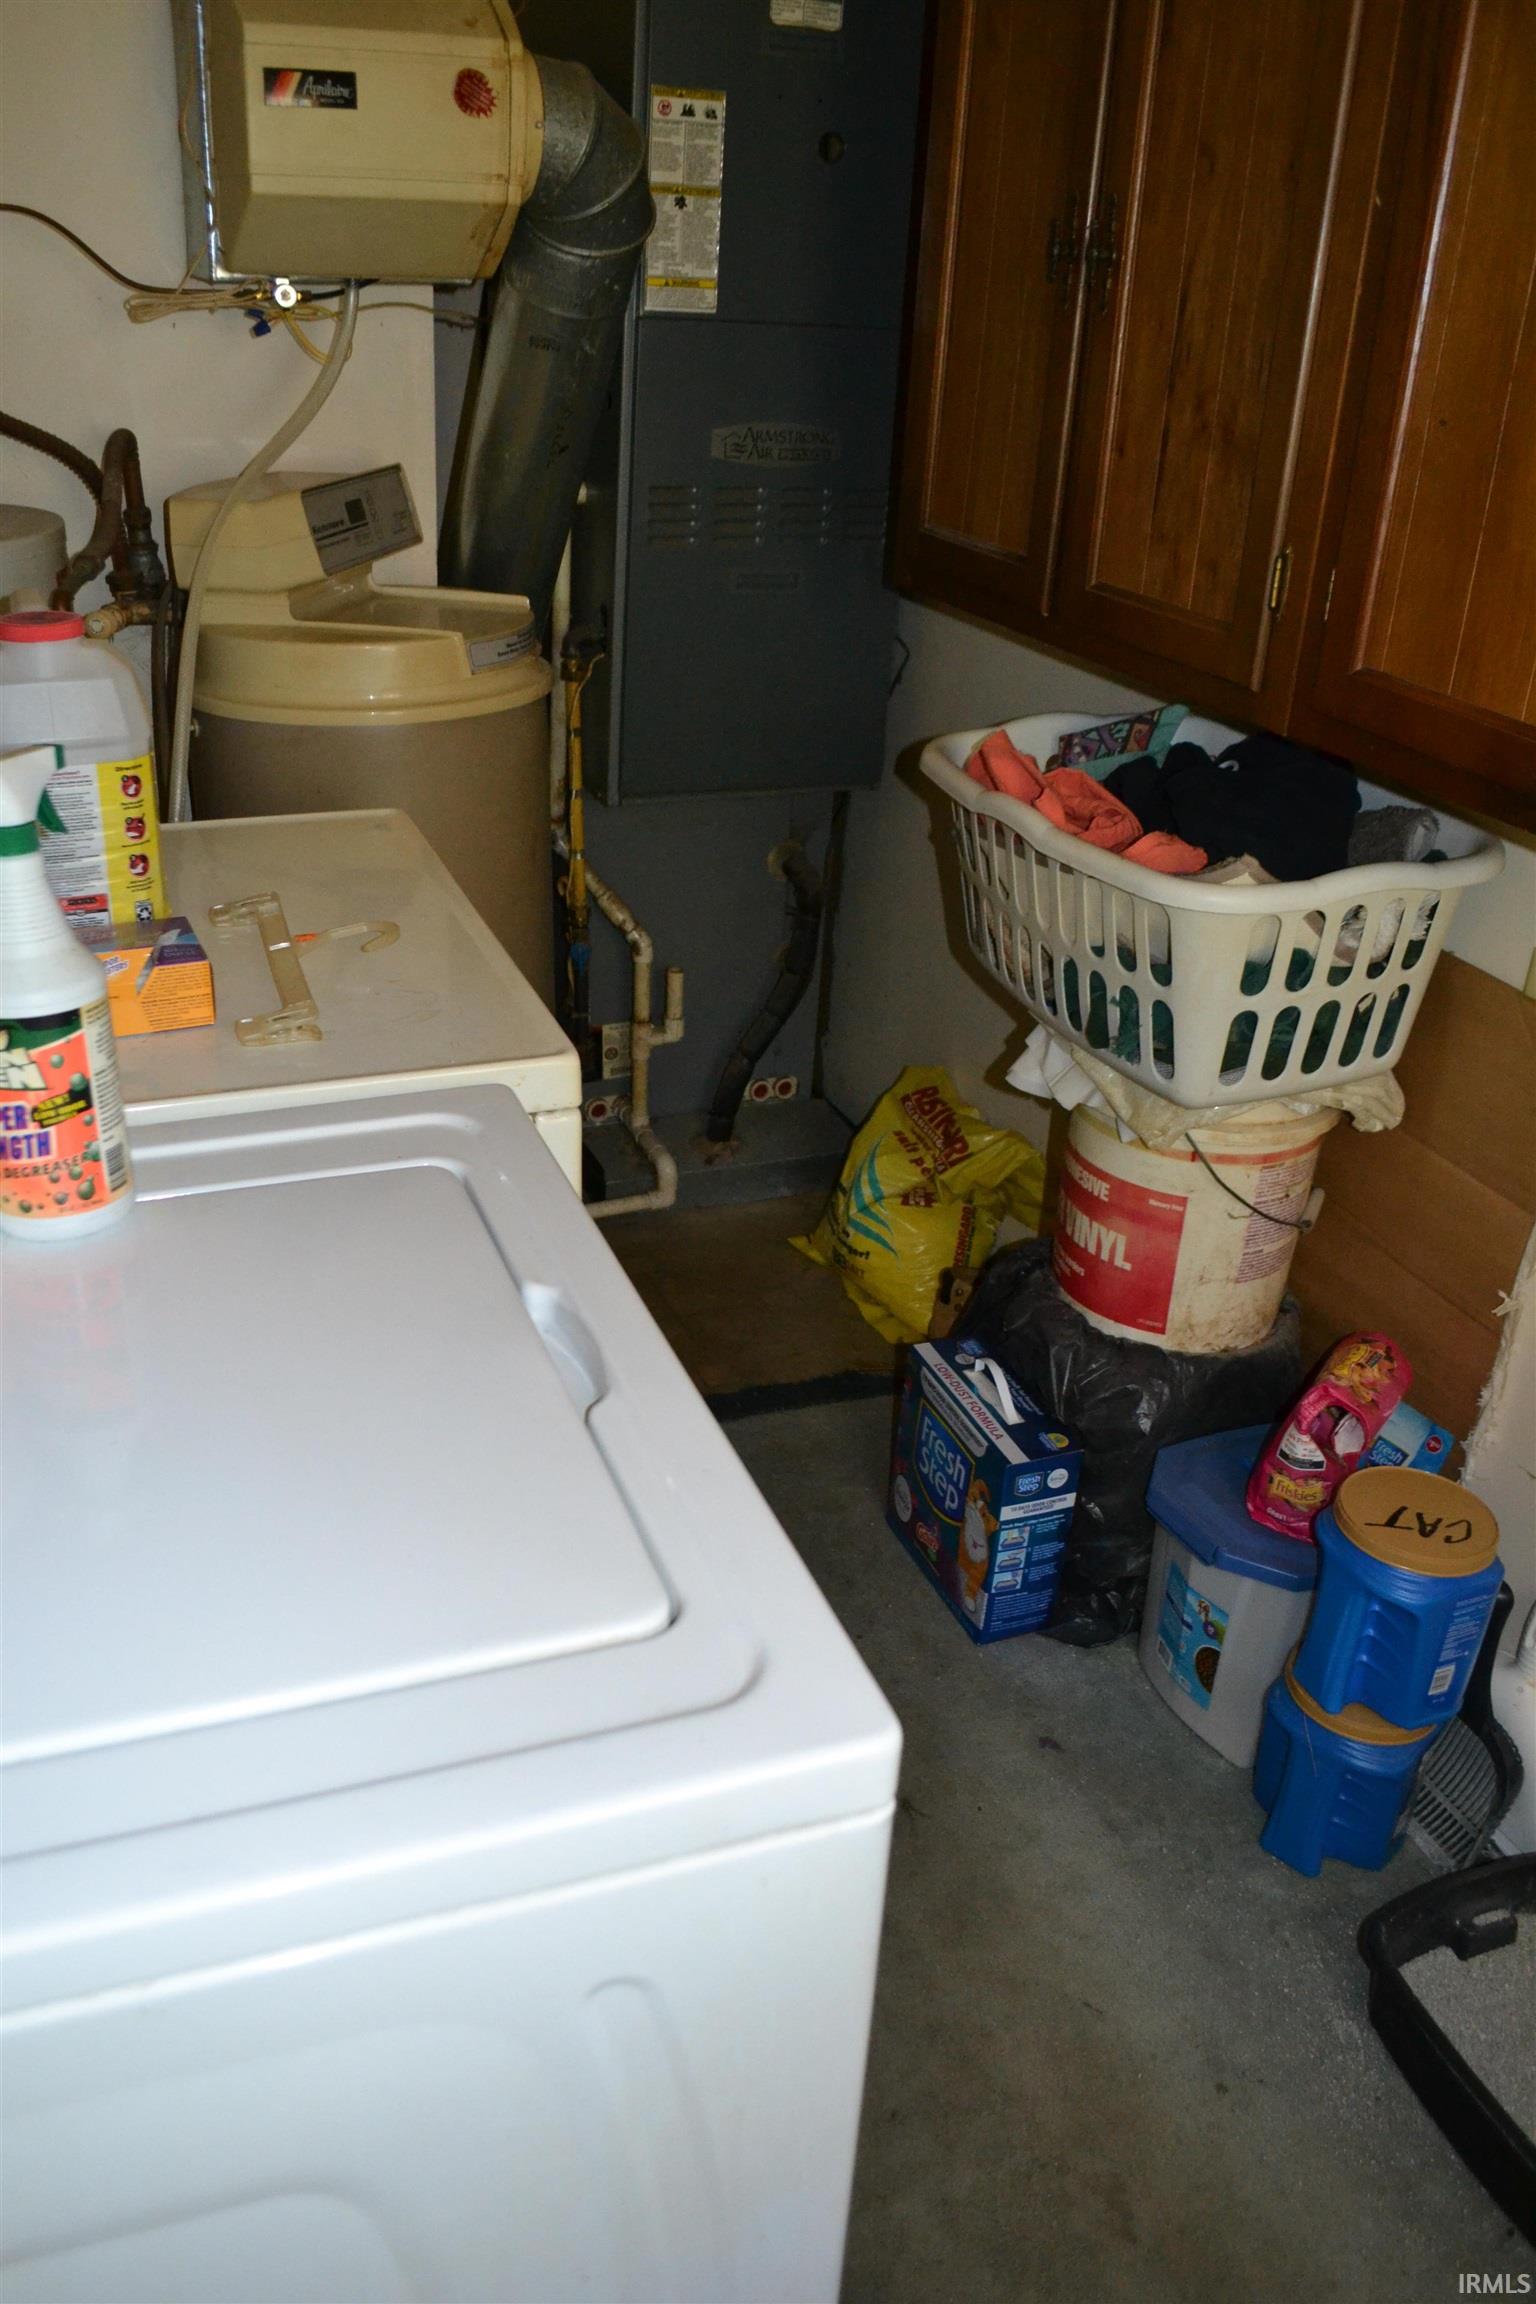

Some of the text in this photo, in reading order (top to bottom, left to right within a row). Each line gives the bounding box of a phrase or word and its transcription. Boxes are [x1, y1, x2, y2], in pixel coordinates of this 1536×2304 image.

[1066, 1205, 1132, 1271] VINYL
[968, 1400, 1004, 1442] FORMULA
[918, 1447, 959, 1511] Step
[920, 1415, 966, 1490] Fresh
[1275, 1478, 1318, 1501] Friskies
[1364, 1506, 1472, 1544] CAT
